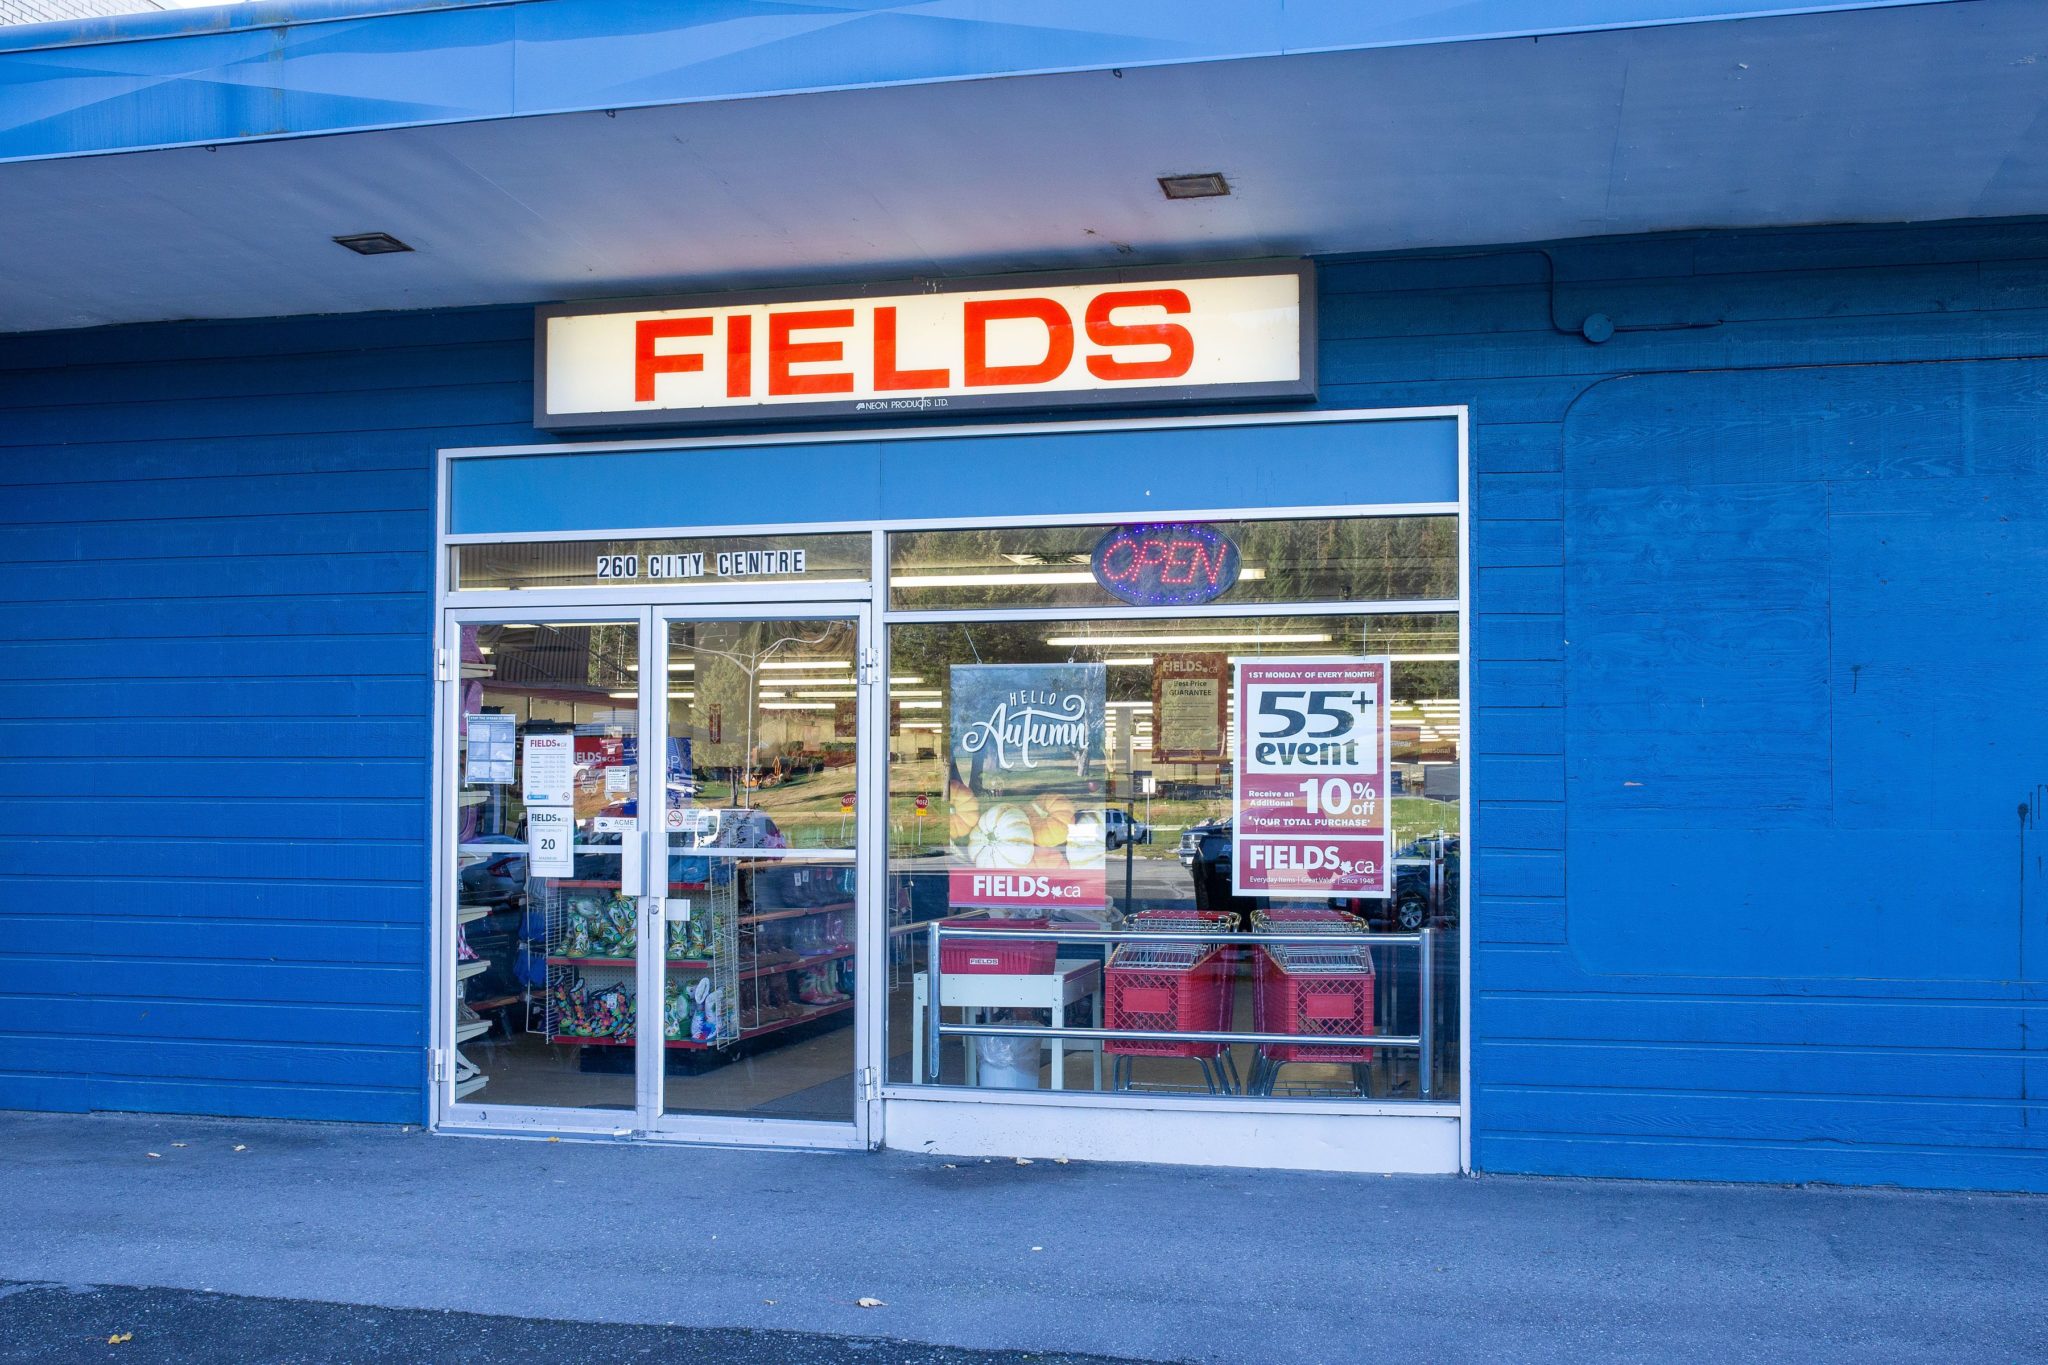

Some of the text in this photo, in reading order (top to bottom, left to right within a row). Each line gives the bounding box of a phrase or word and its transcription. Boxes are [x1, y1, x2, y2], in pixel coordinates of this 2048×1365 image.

[635, 288, 1195, 402] FIELDS
[865, 398, 949, 410] NEON PRODUCTS LTD.
[598, 551, 803, 578] 260 CITY CENTRE
[1101, 538, 1228, 585] OPEN
[1248, 671, 1264, 679] 1ST
[1265, 671, 1303, 679] MONDAY
[1009, 689, 1058, 707] HELLO
[961, 693, 1090, 770] Autumn
[1255, 738, 1360, 767] event
[1248, 790, 1282, 798] Receive
[1249, 799, 1294, 807] Additional
[1351, 801, 1375, 816] off
[1283, 818, 1312, 827] TOTAL
[540, 838, 556, 851] 20
[1359, 877, 1375, 885] 1948
